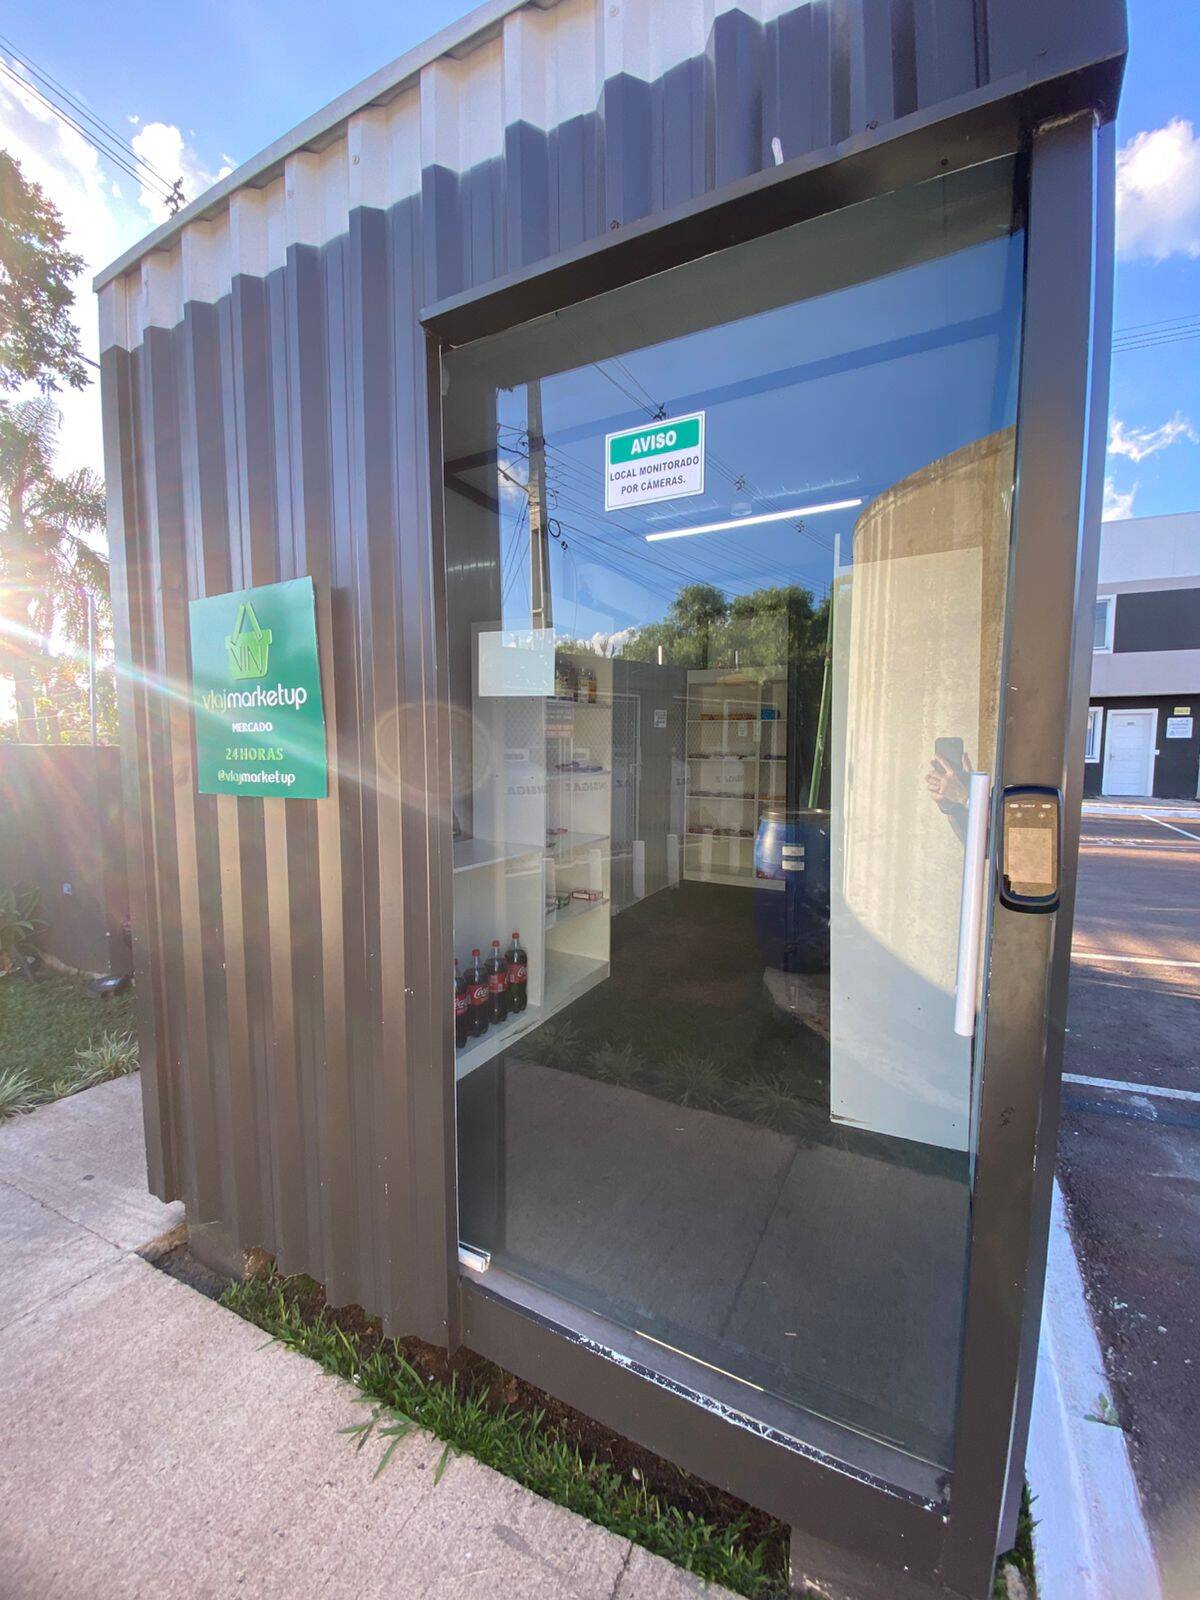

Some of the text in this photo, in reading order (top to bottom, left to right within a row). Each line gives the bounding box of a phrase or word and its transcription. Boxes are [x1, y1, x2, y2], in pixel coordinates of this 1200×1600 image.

[631, 431, 677, 455] AVISO
[610, 456, 699, 482] LOCAL MONITORADO
[621, 484, 639, 495] POR
[231, 722, 273, 732] MERCADO
